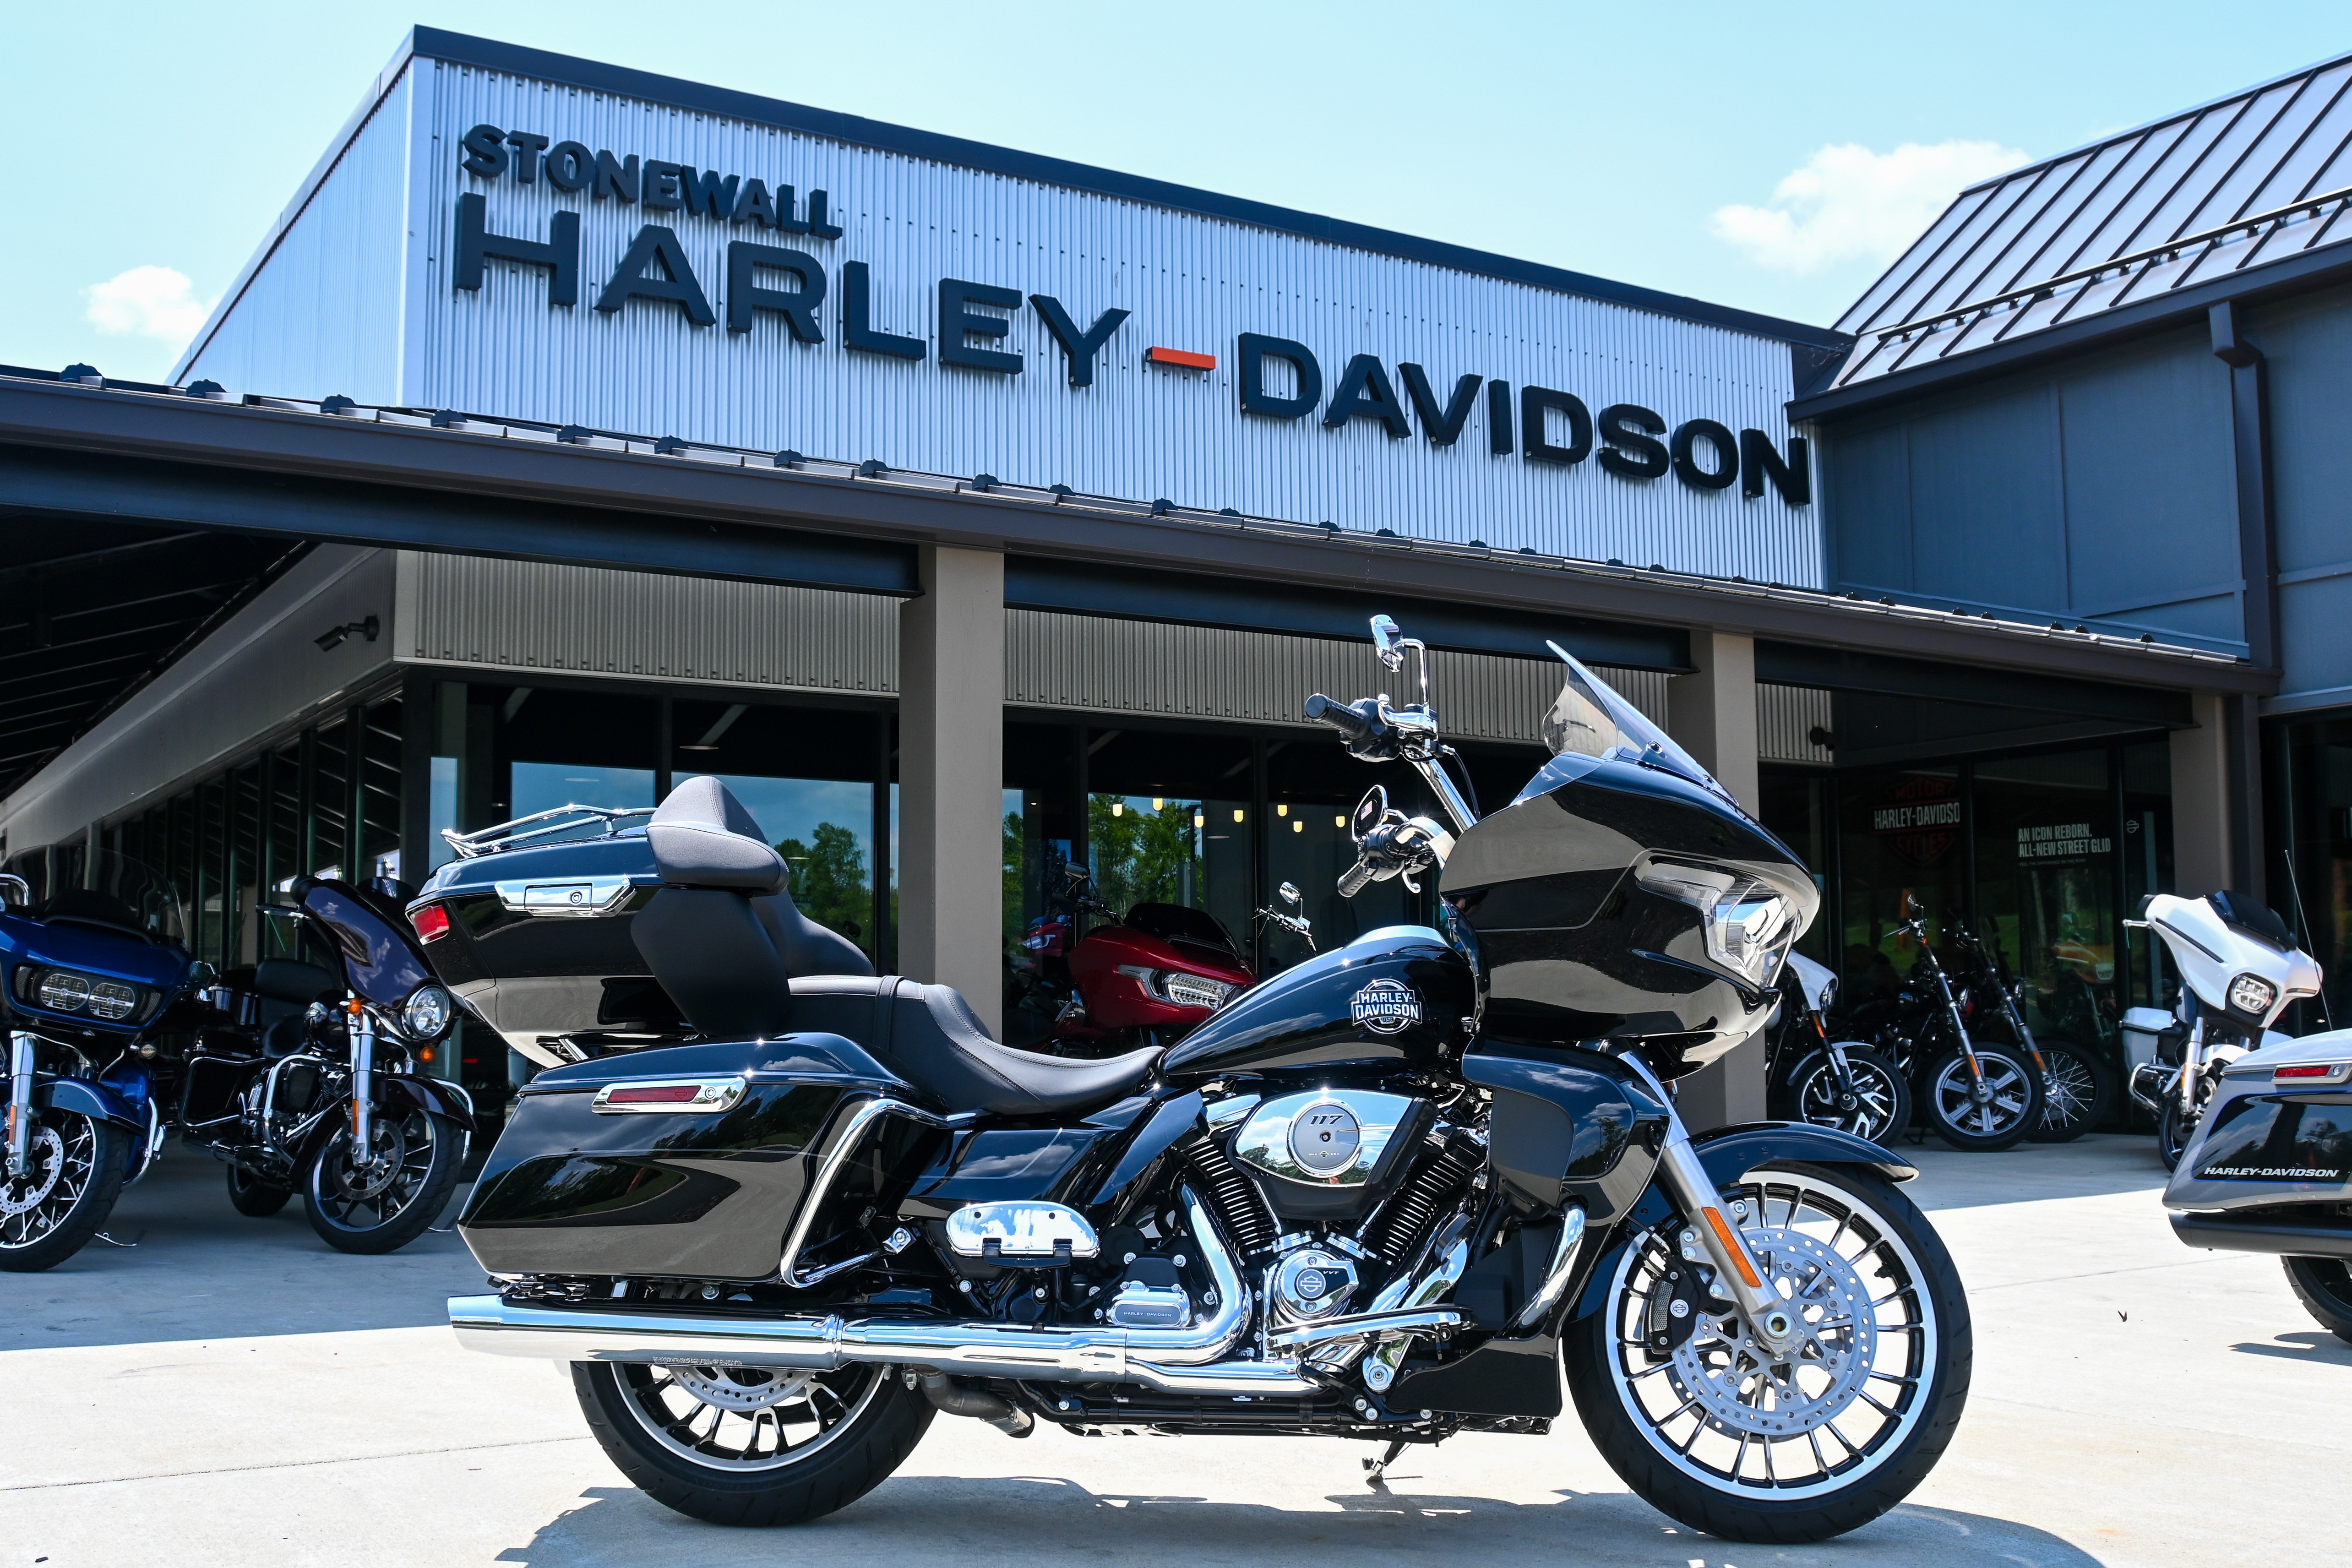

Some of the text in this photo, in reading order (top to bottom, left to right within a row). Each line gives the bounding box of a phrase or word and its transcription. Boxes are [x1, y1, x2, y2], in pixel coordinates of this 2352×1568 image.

[461, 124, 843, 241] STONEWALL
[2019, 823, 2092, 842] AN ICON REBORN.
[2019, 842, 2056, 858] ALL-NEW
[2058, 839, 2089, 855] STREET
[1361, 992, 1413, 1004] HARLEY-
[1355, 1004, 1419, 1020] DAVIDSON
[1309, 1114, 1345, 1126] 117
[2204, 1167, 2339, 1177] HARLEY-DAVIDSON
